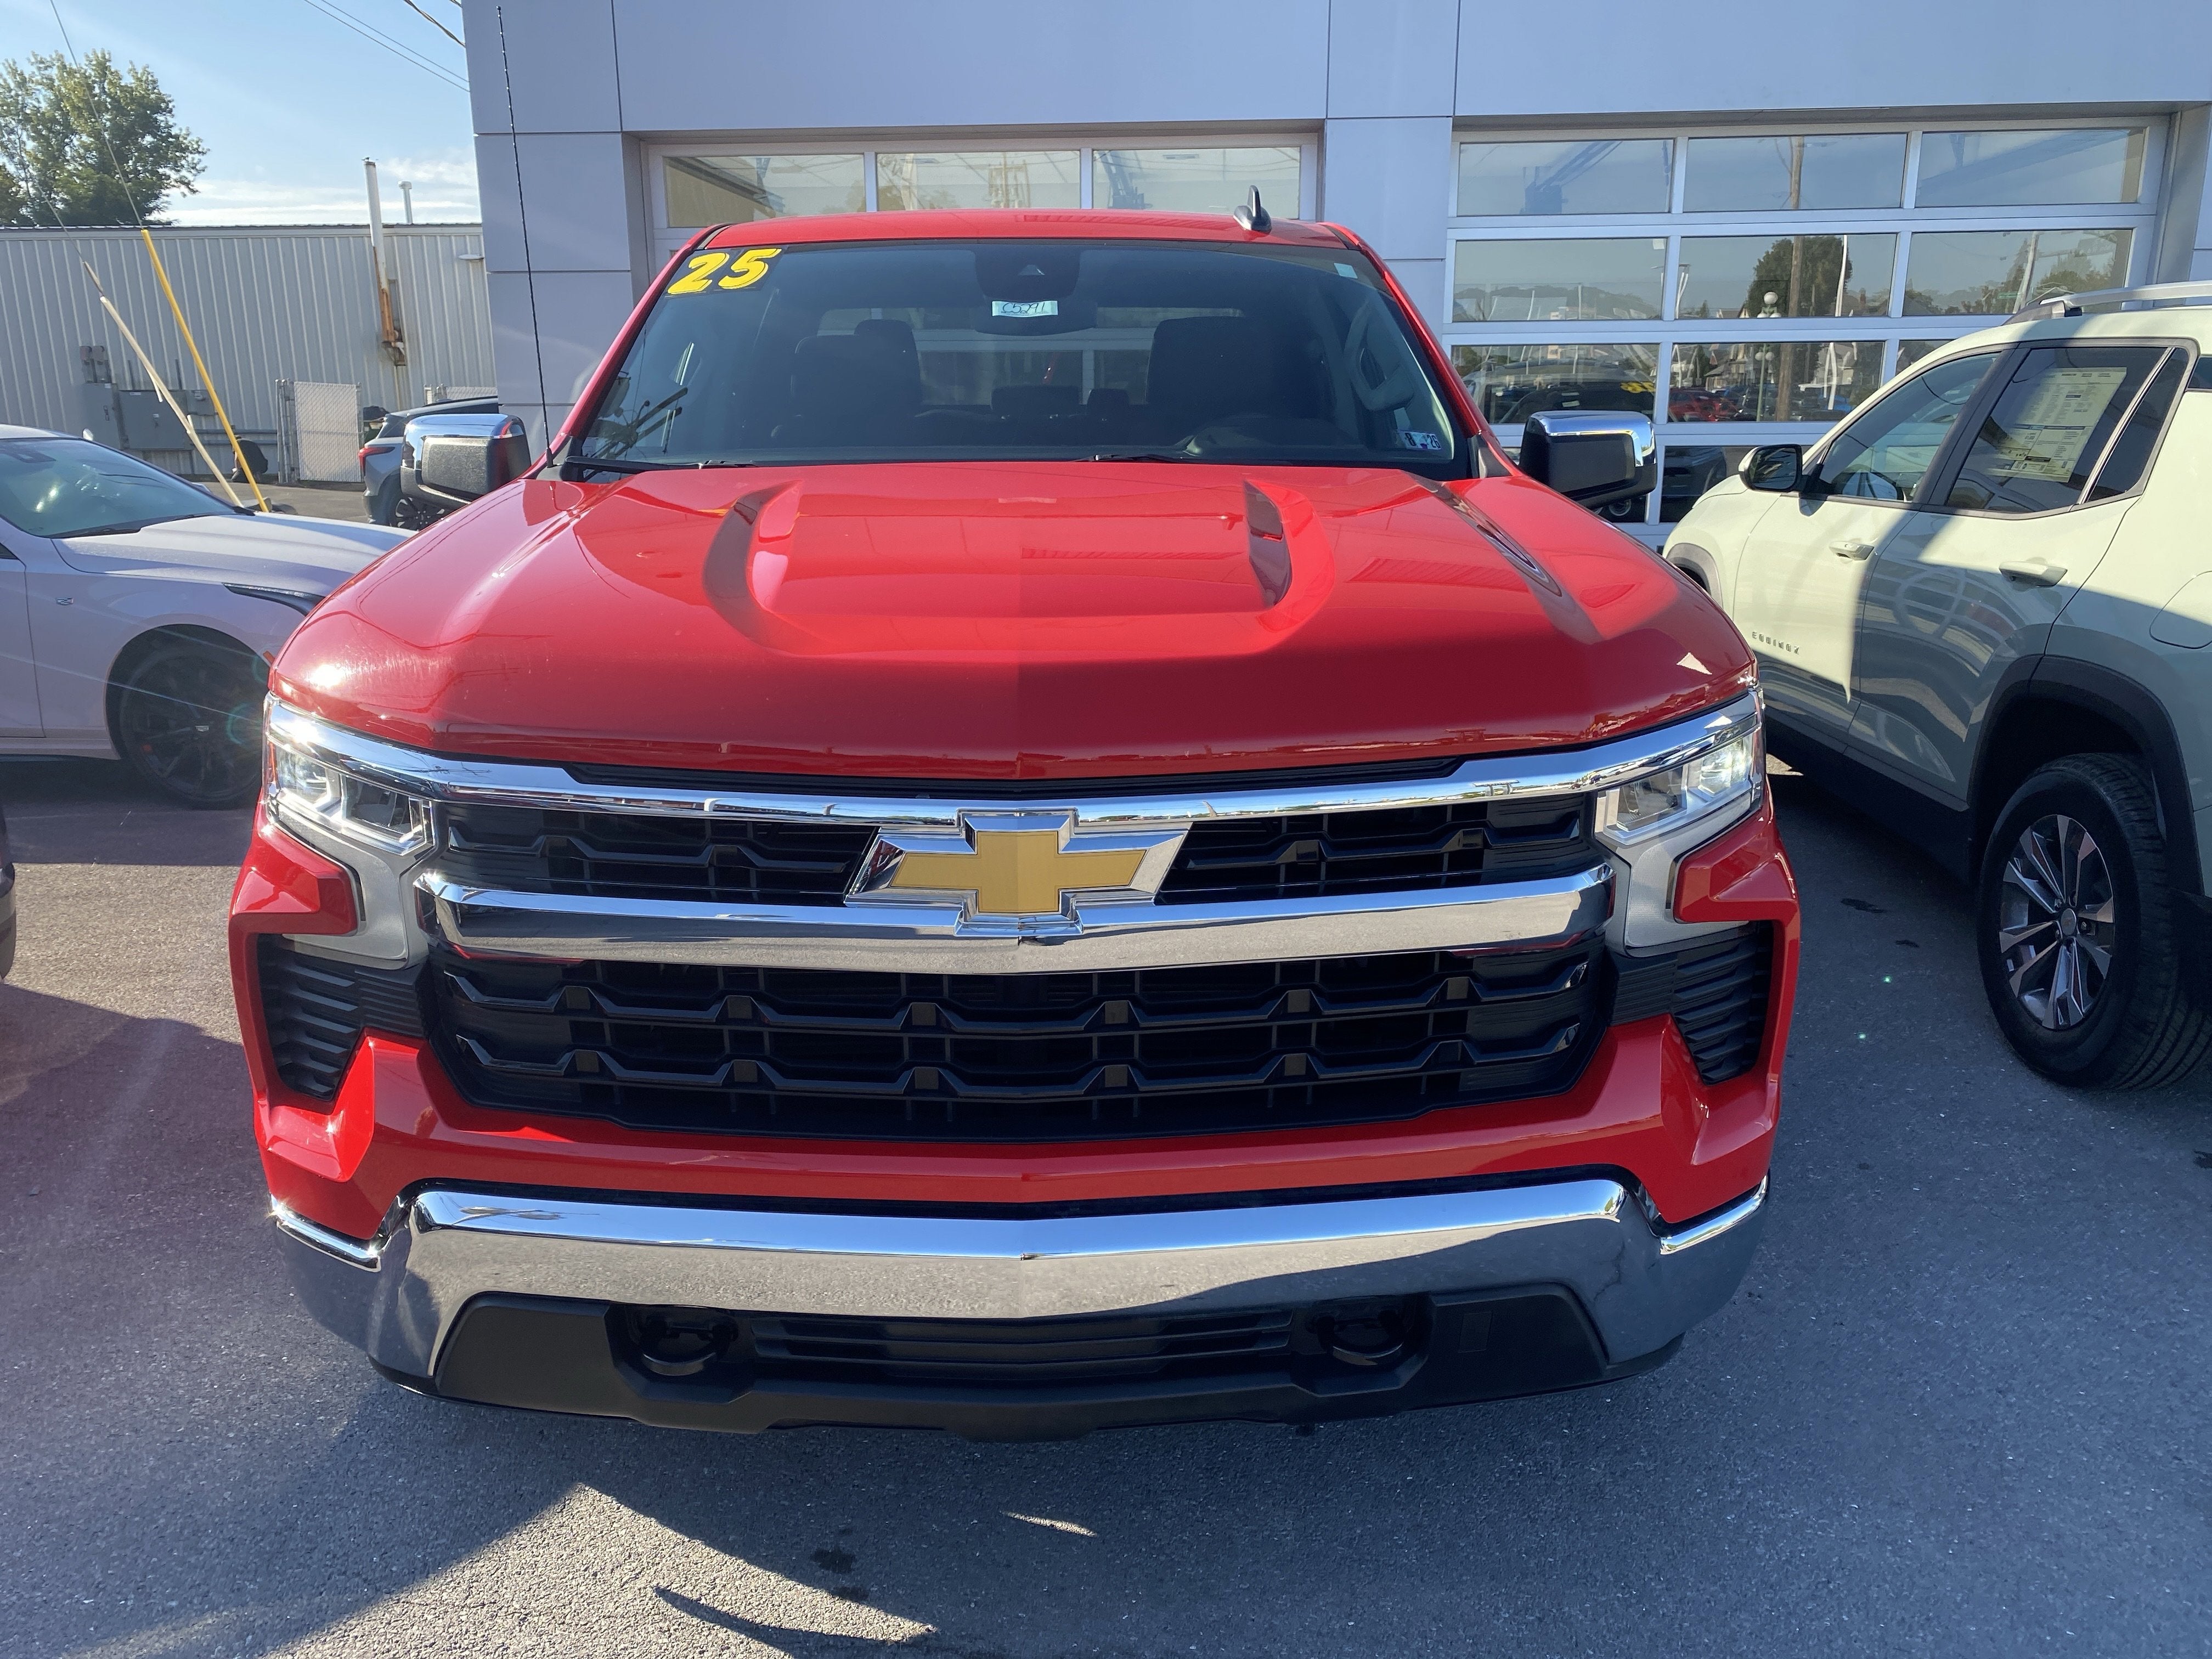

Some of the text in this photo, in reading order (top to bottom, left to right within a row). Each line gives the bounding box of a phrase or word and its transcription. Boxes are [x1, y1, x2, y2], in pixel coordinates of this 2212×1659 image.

[667, 248, 782, 295] 25
[1404, 432, 1441, 448] 8 26
[1752, 631, 1799, 654] EQUINOX
